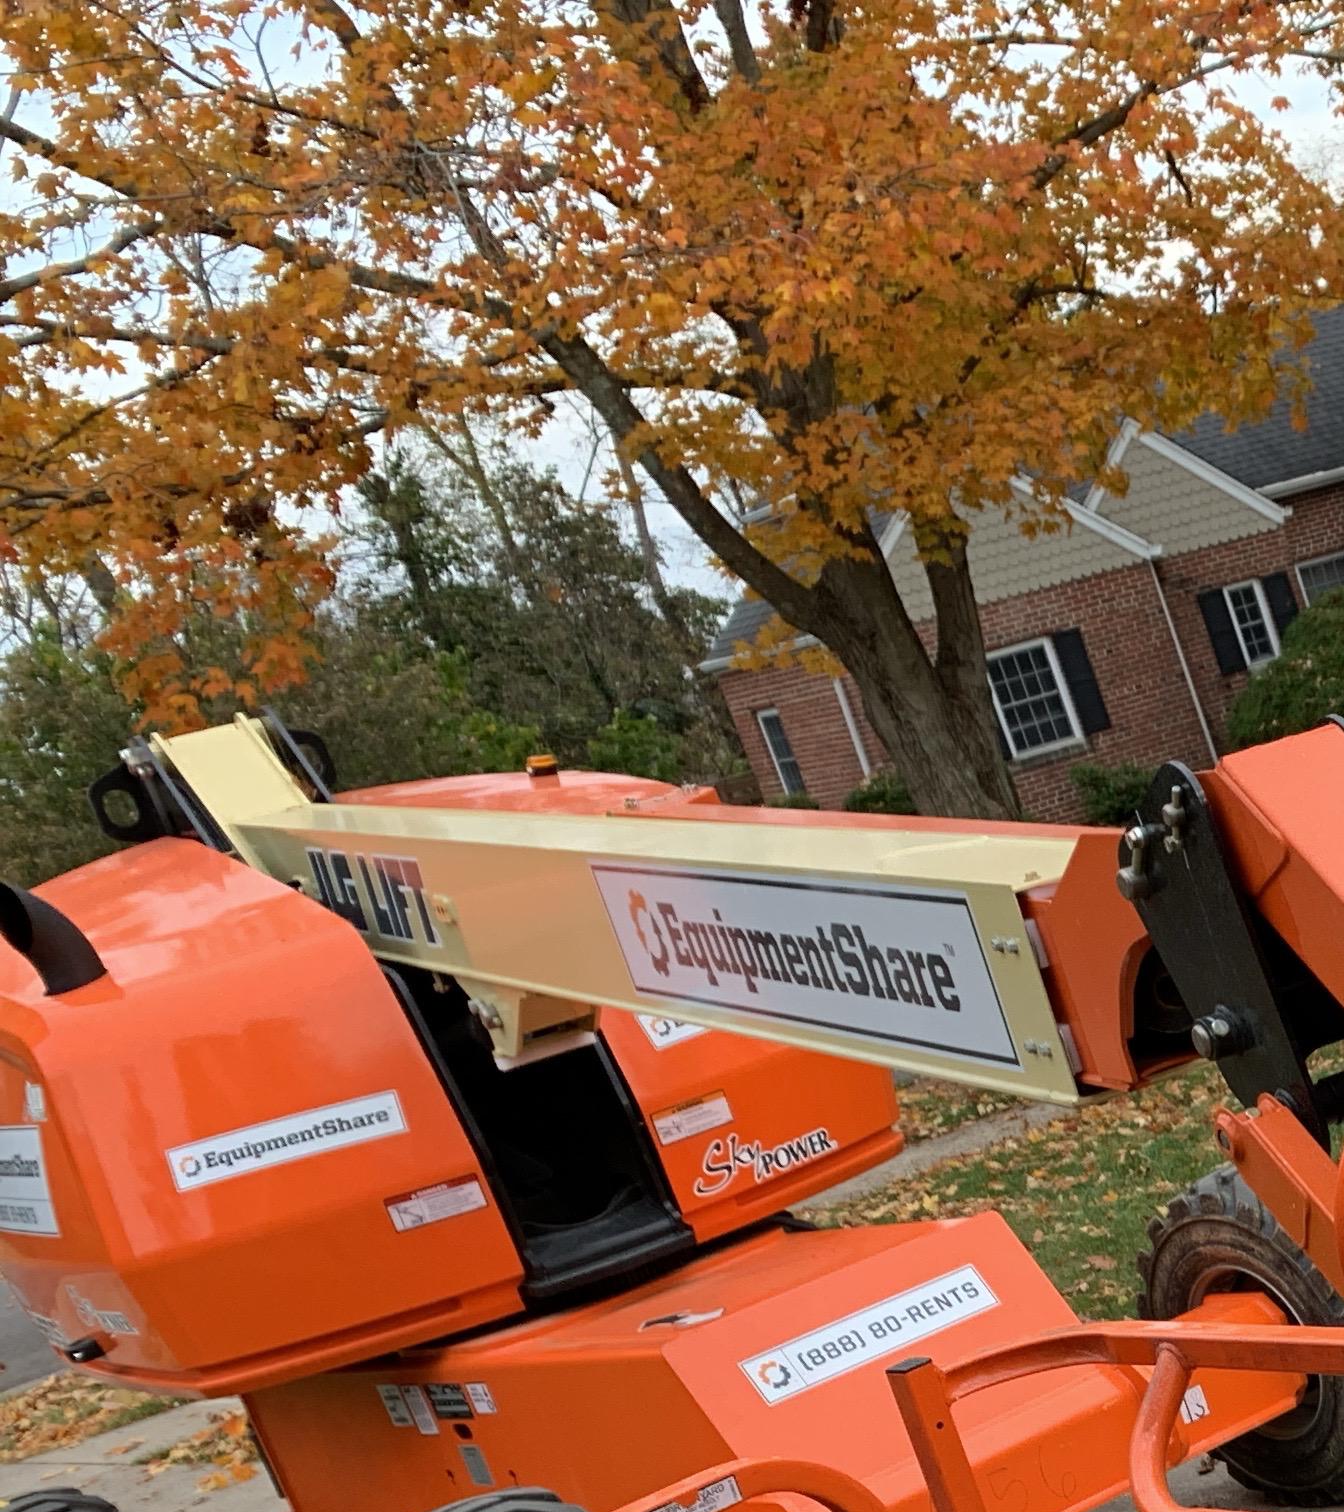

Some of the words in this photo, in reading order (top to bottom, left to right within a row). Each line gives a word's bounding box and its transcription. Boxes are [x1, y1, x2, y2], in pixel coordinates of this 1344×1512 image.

[354, 852, 443, 947] LIFT
[656, 901, 961, 1013] EquipmentShare
[203, 1109, 389, 1170] EquipmentShare
[796, 1329, 867, 1372] (888)
[867, 1281, 980, 1340] 80-RENTS
